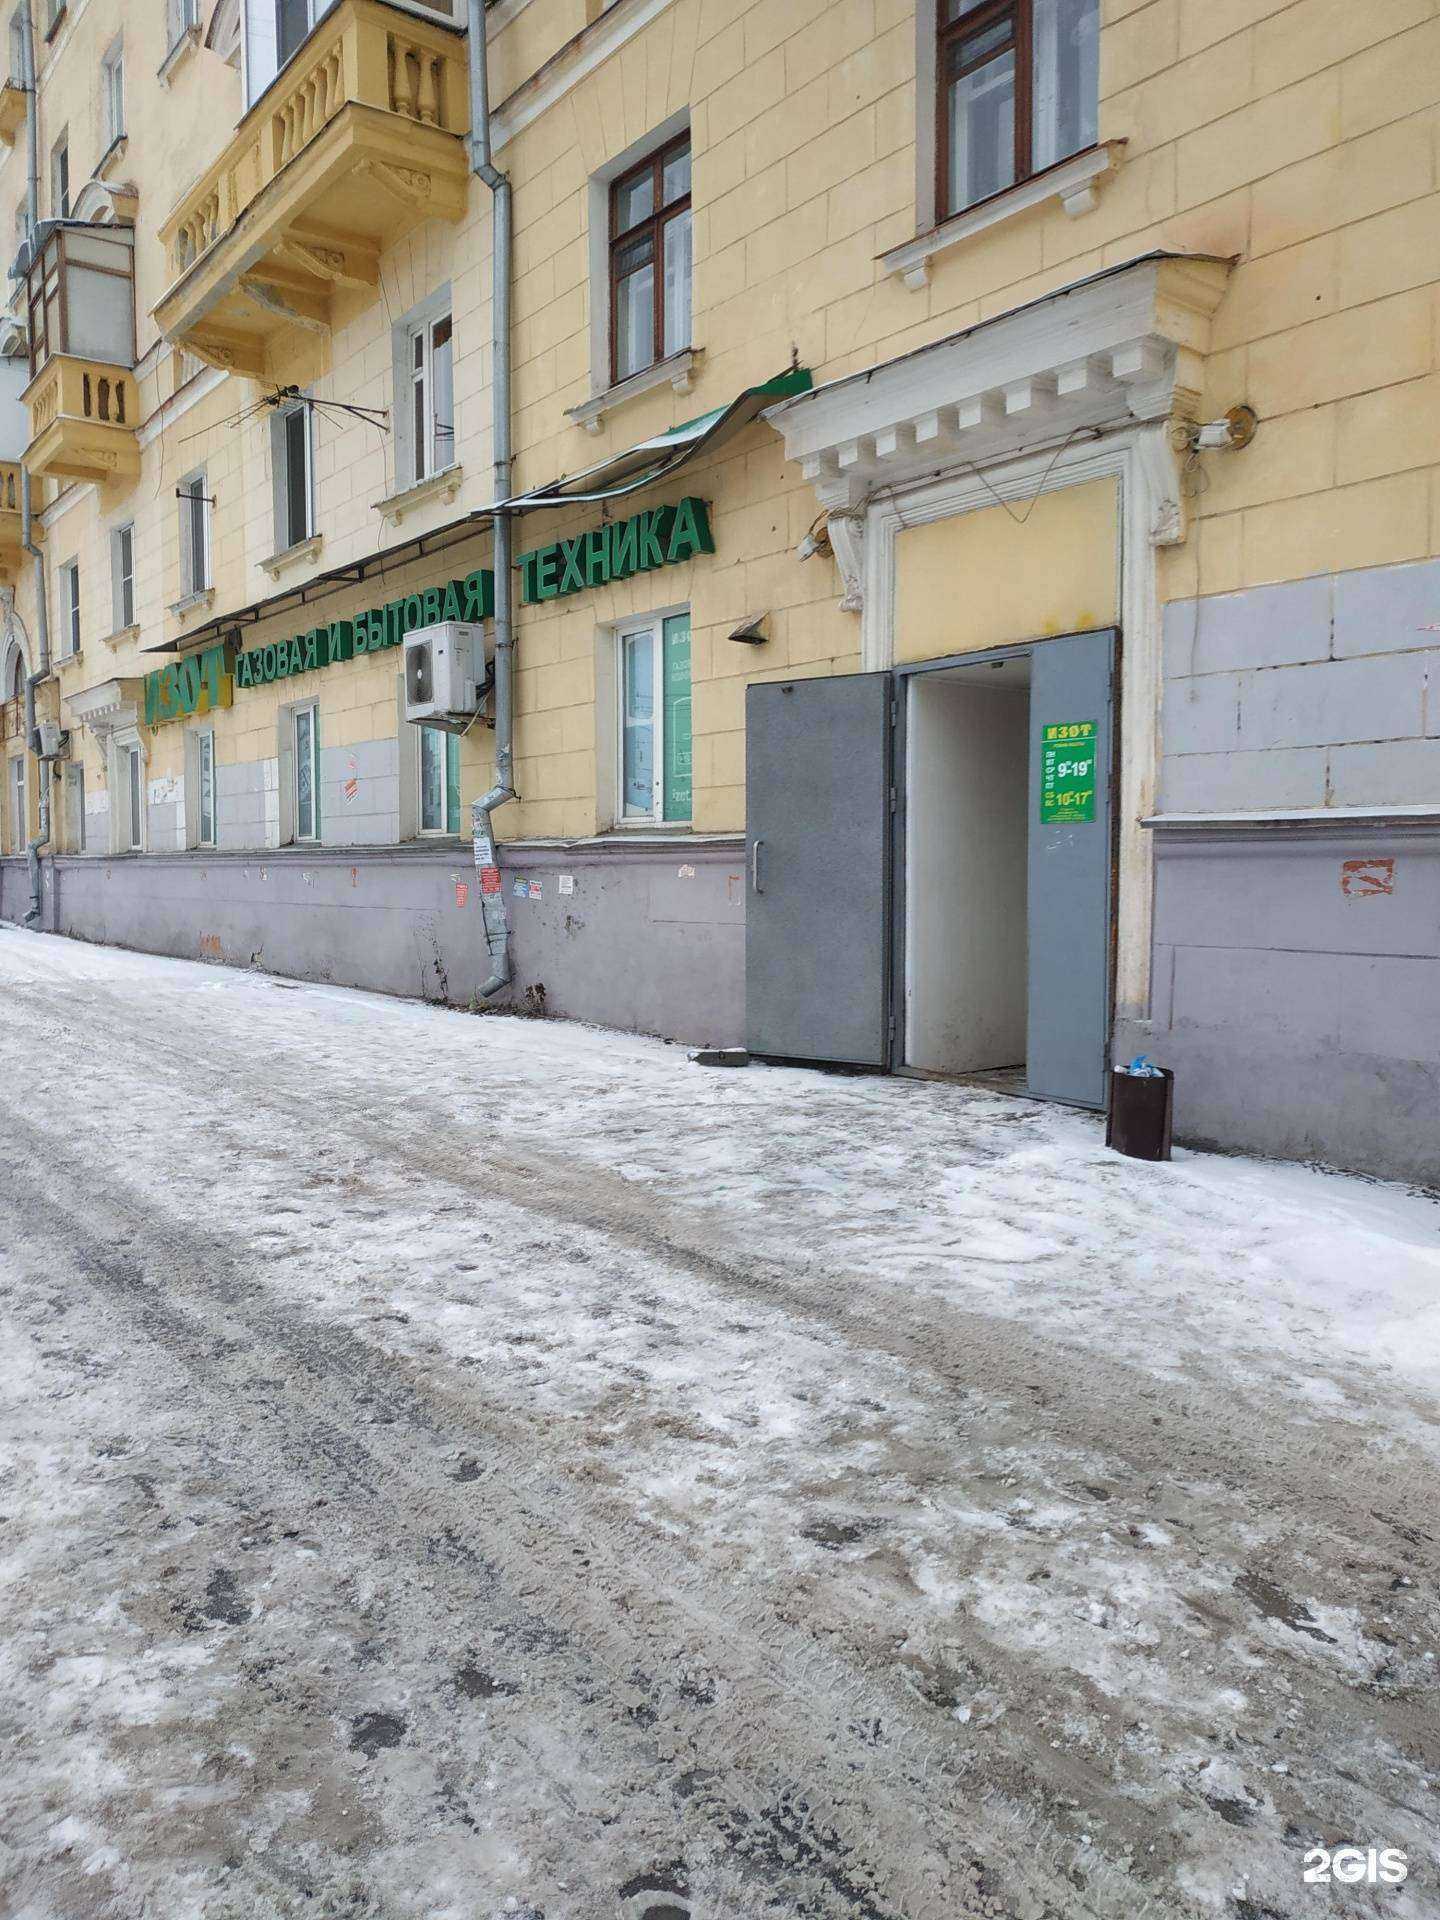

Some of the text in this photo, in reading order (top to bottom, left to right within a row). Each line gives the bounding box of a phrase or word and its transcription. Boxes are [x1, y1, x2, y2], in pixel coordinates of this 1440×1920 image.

[145, 496, 706, 725] ИЗОТ ГАЗОВАЯ И БЫТОВАЯ ТЕХНИКА
[1047, 724, 1092, 739] ИЗОТ
